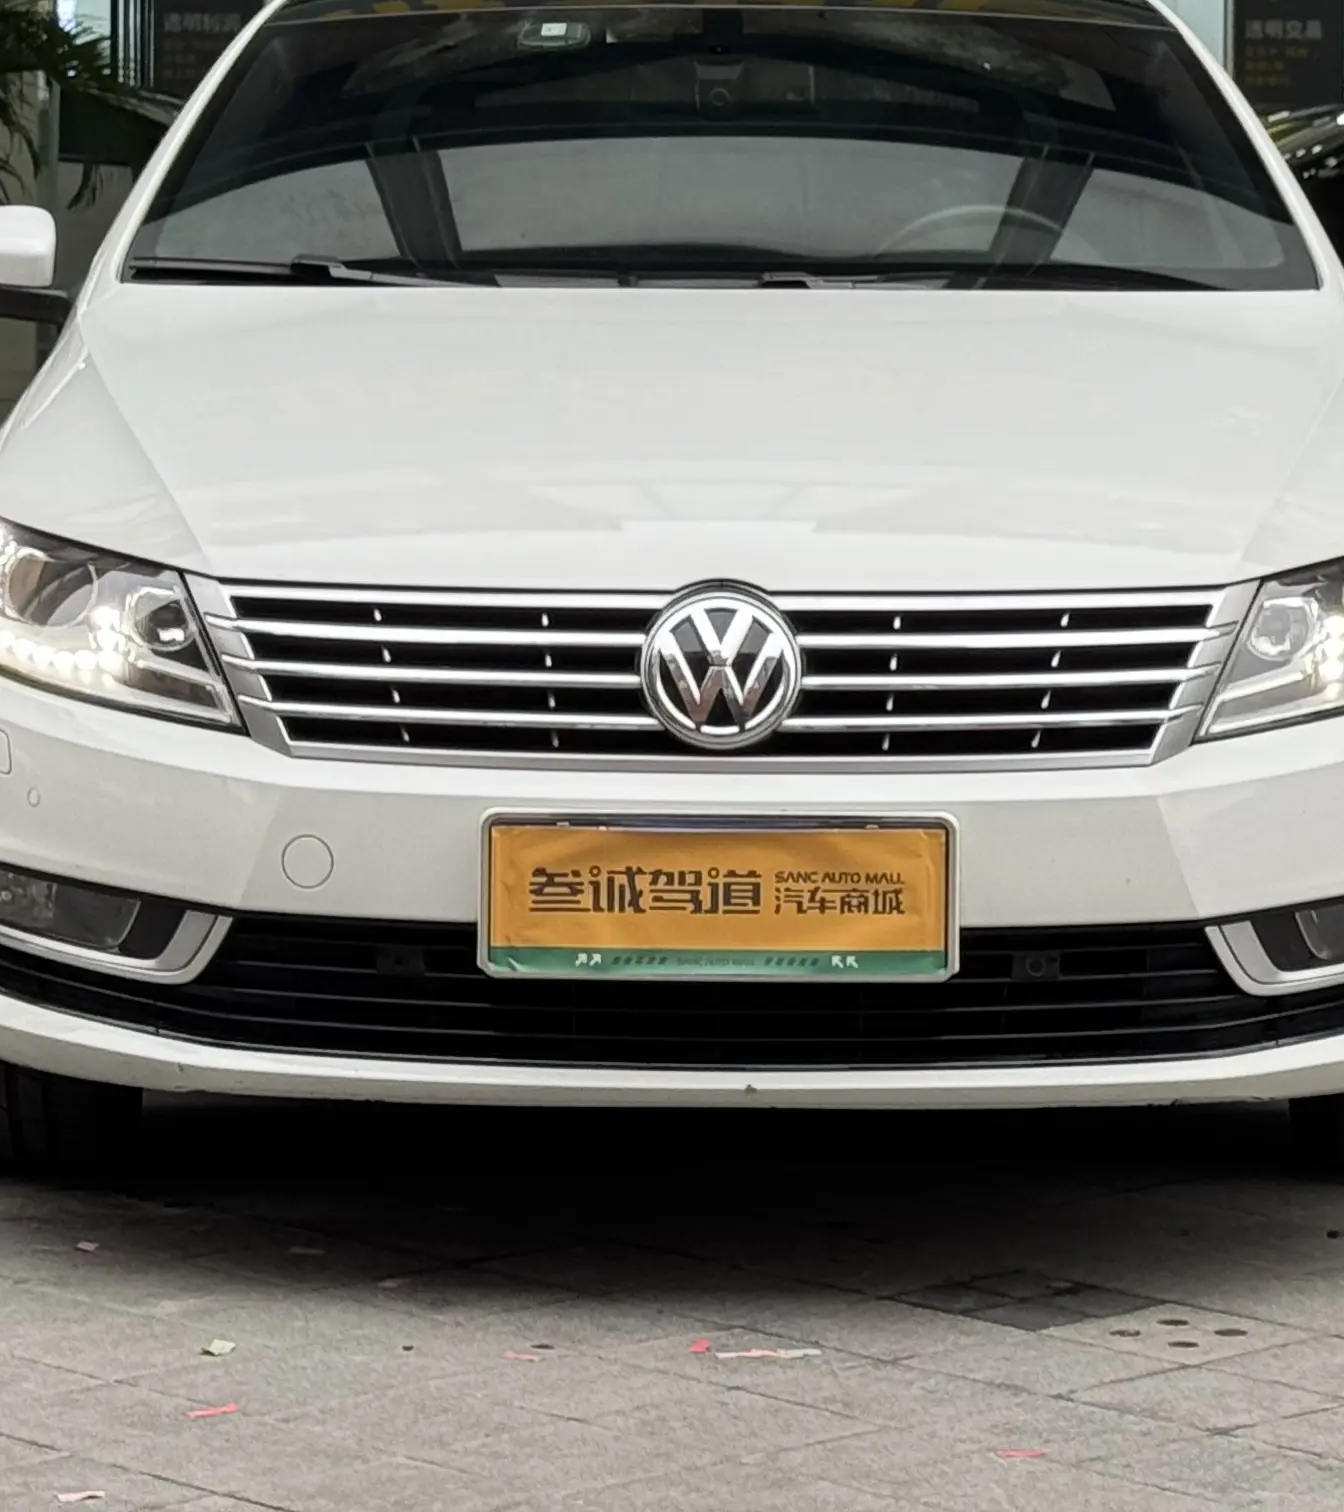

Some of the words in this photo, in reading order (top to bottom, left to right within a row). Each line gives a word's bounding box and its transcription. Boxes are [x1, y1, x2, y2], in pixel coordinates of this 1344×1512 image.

[528, 864, 762, 916] 叁诚驾道
[774, 870, 819, 884] SANC
[821, 871, 862, 885] AUTO
[864, 871, 905, 885] MALL
[774, 886, 905, 915] 汽车商城
